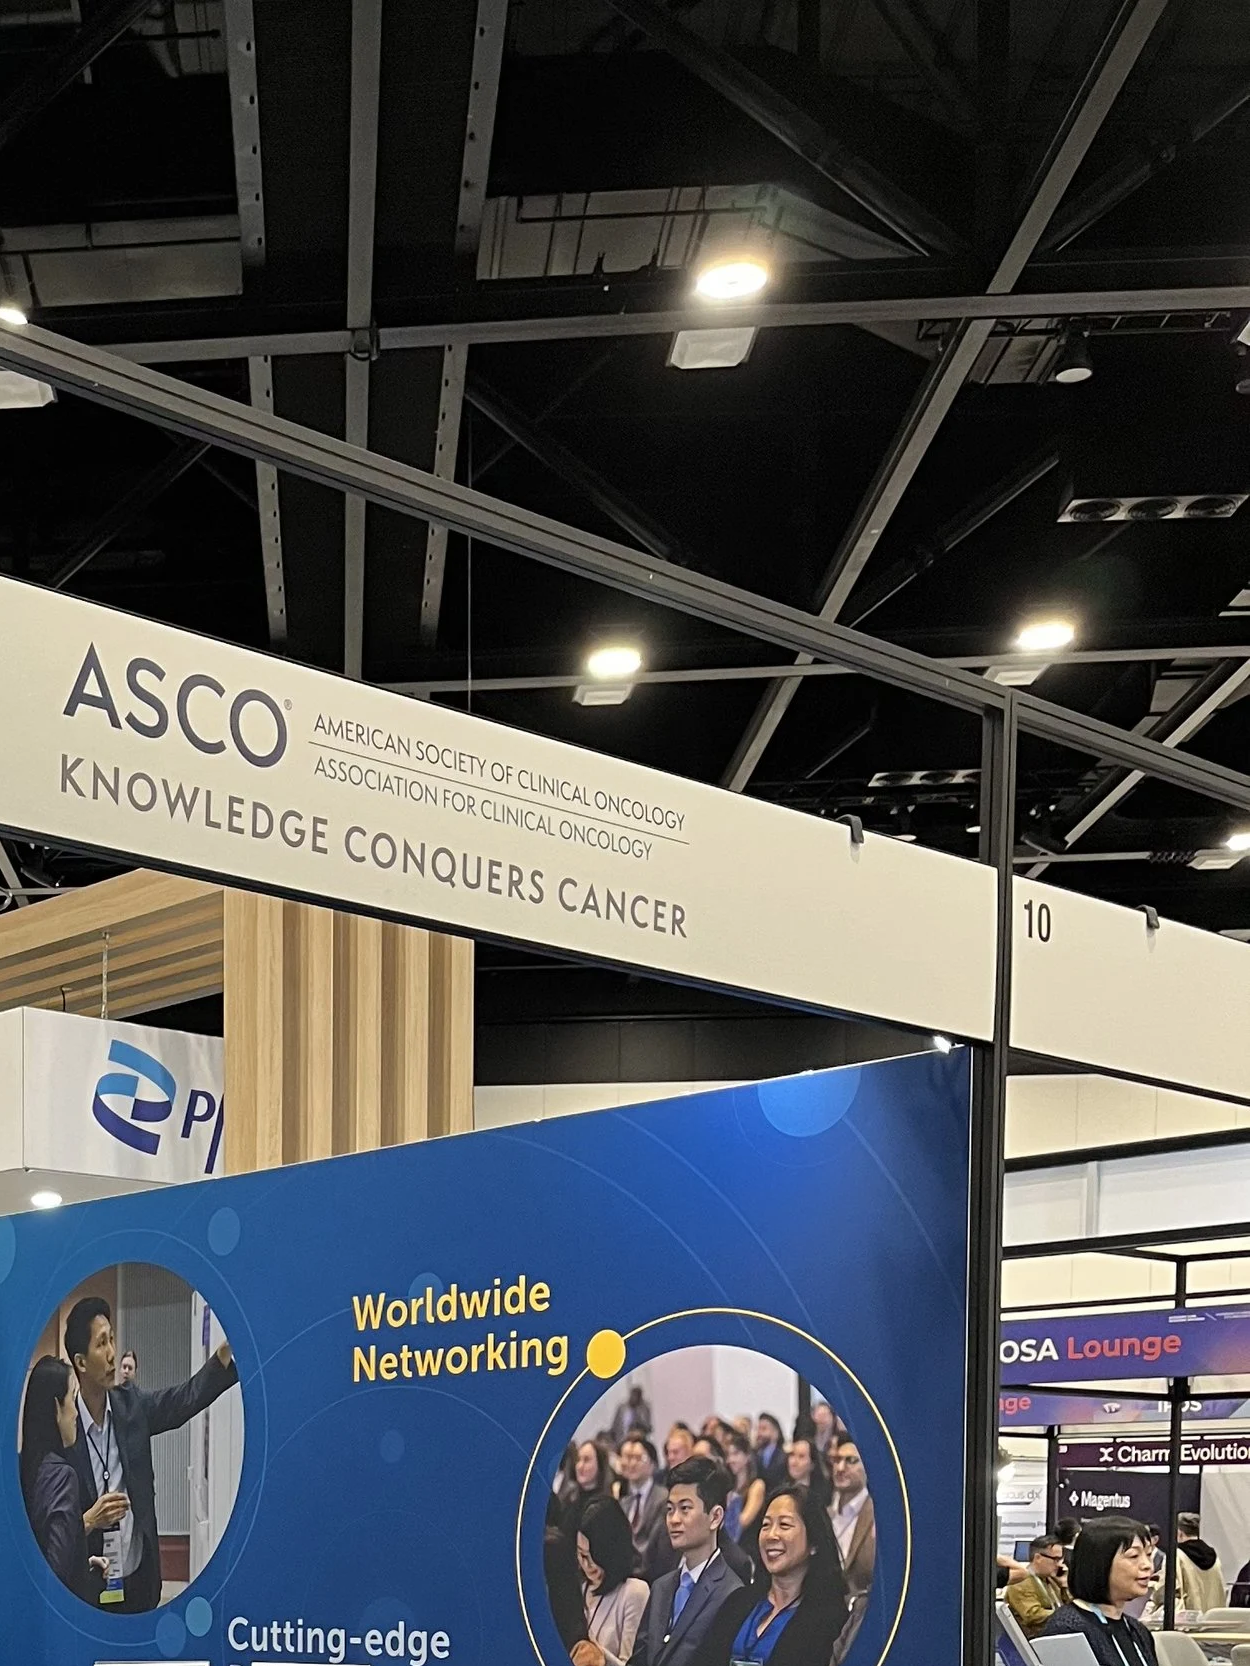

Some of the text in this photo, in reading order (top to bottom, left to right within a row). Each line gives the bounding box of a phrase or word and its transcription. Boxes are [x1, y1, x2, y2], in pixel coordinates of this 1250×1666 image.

[314, 713, 685, 831] AMERICAN SOCIETY OF CLINICAL ONCOLOGY
[314, 756, 653, 861] ASSOCIATION FOR CLINICAL ONCOLOGY
[60, 753, 688, 939] KNOWLEDGE CONQUERS CANCER
[1024, 899, 1052, 943] 10
[352, 1274, 551, 1332] Worldwide
[352, 1329, 569, 1383] Networking
[1067, 1334, 1182, 1361] Lounge
[1180, 1444, 1250, 1461] Evolutio
[1081, 1491, 1131, 1511] Magentus
